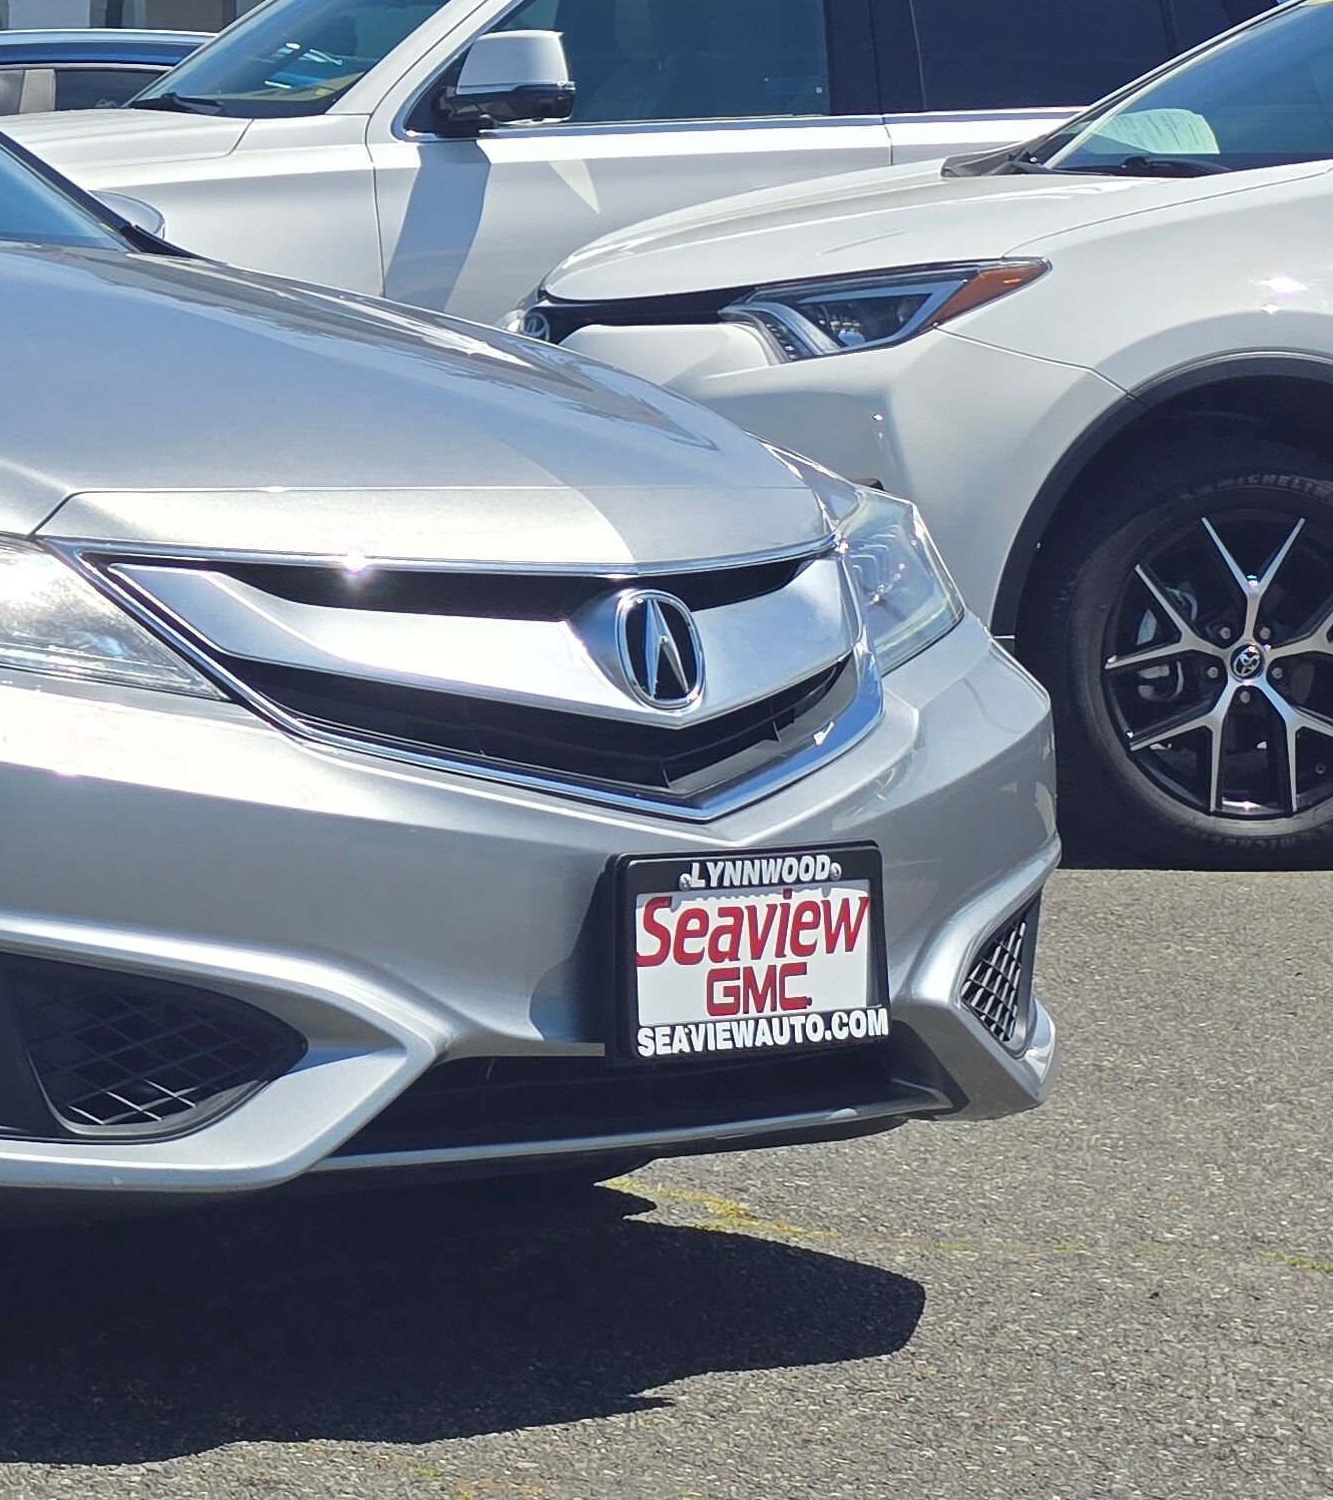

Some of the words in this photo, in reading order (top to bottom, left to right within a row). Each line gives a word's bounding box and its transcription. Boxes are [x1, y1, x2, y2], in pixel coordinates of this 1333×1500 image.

[690, 854, 831, 888] LYNNWOOD
[636, 888, 869, 967] Seaview
[706, 962, 809, 1017] GMC
[637, 1009, 889, 1057] SEAVIEWAUTO.COM
